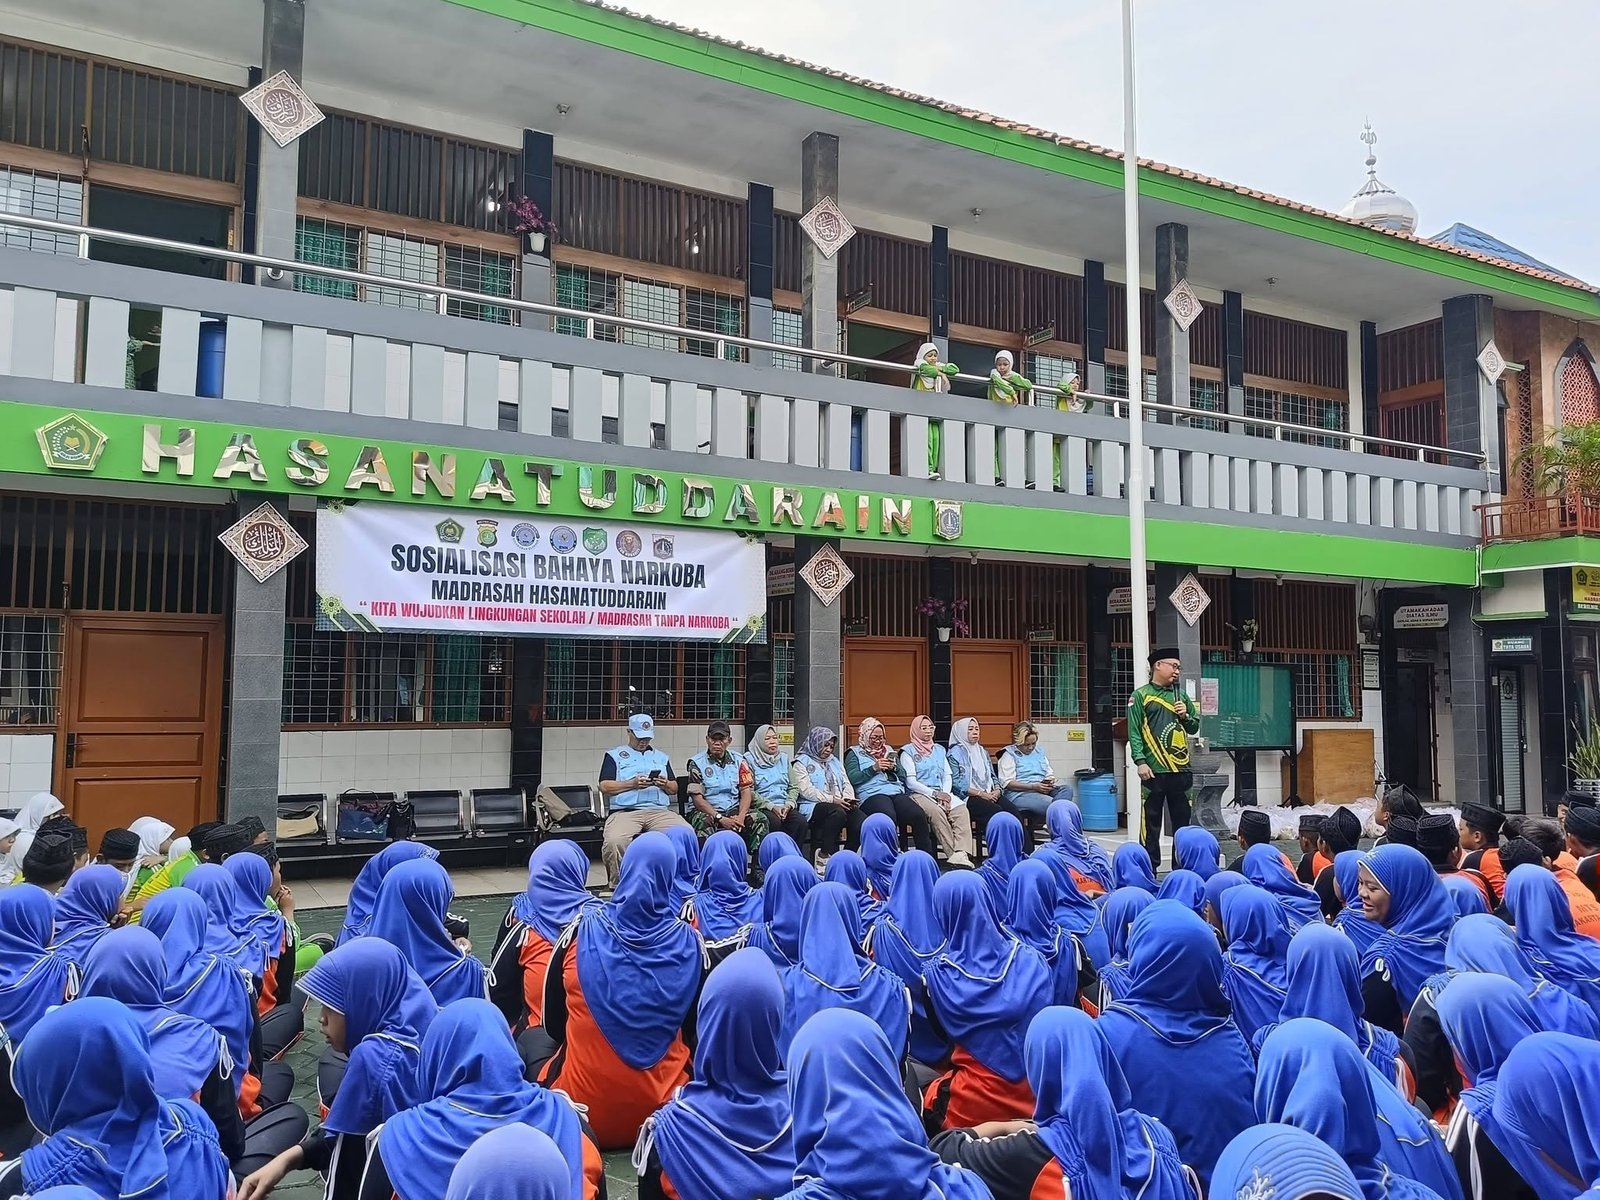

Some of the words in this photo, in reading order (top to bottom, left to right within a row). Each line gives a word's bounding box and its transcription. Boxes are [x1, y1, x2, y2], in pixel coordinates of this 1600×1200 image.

[141, 423, 913, 535] HASANATUDDARAIN
[391, 543, 526, 579] SOSIALISASI
[534, 554, 615, 584] BAHAYA
[621, 559, 706, 589] NARKOBA
[431, 580, 524, 604] MADRASAH
[529, 584, 667, 611] HASANATUDDARAIN
[371, 601, 397, 617] KITA
[400, 602, 465, 620] WUJUDKAN
[468, 606, 537, 622] LINGKUNGAN
[540, 609, 586, 625] SEKOLAH
[597, 612, 652, 627] MADRASAH
[654, 614, 686, 628] TANPA
[688, 616, 730, 629] NARKOBA
